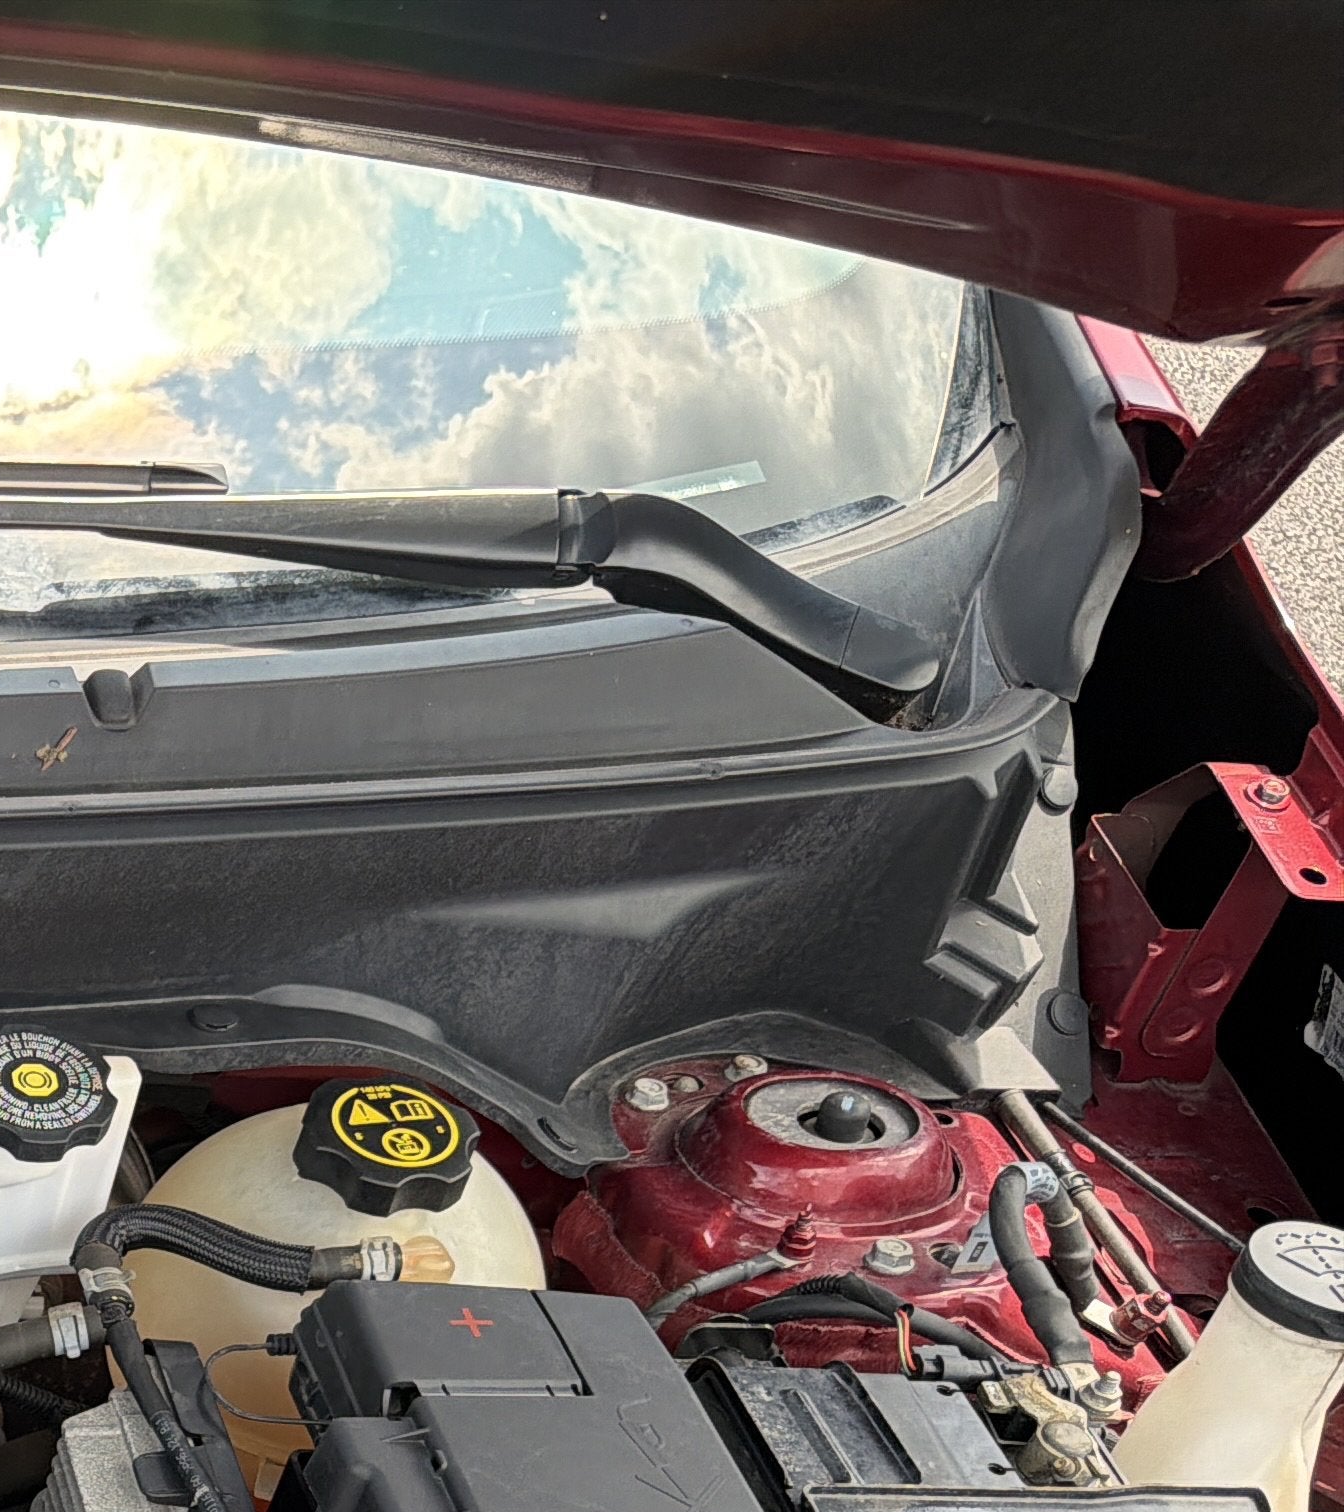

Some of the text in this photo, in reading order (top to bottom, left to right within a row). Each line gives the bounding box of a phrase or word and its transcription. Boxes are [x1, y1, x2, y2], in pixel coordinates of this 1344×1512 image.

[9, 1032, 21, 1042] LE
[21, 1032, 60, 1047] BOUCHON
[10, 1115, 35, 1129] FROM
